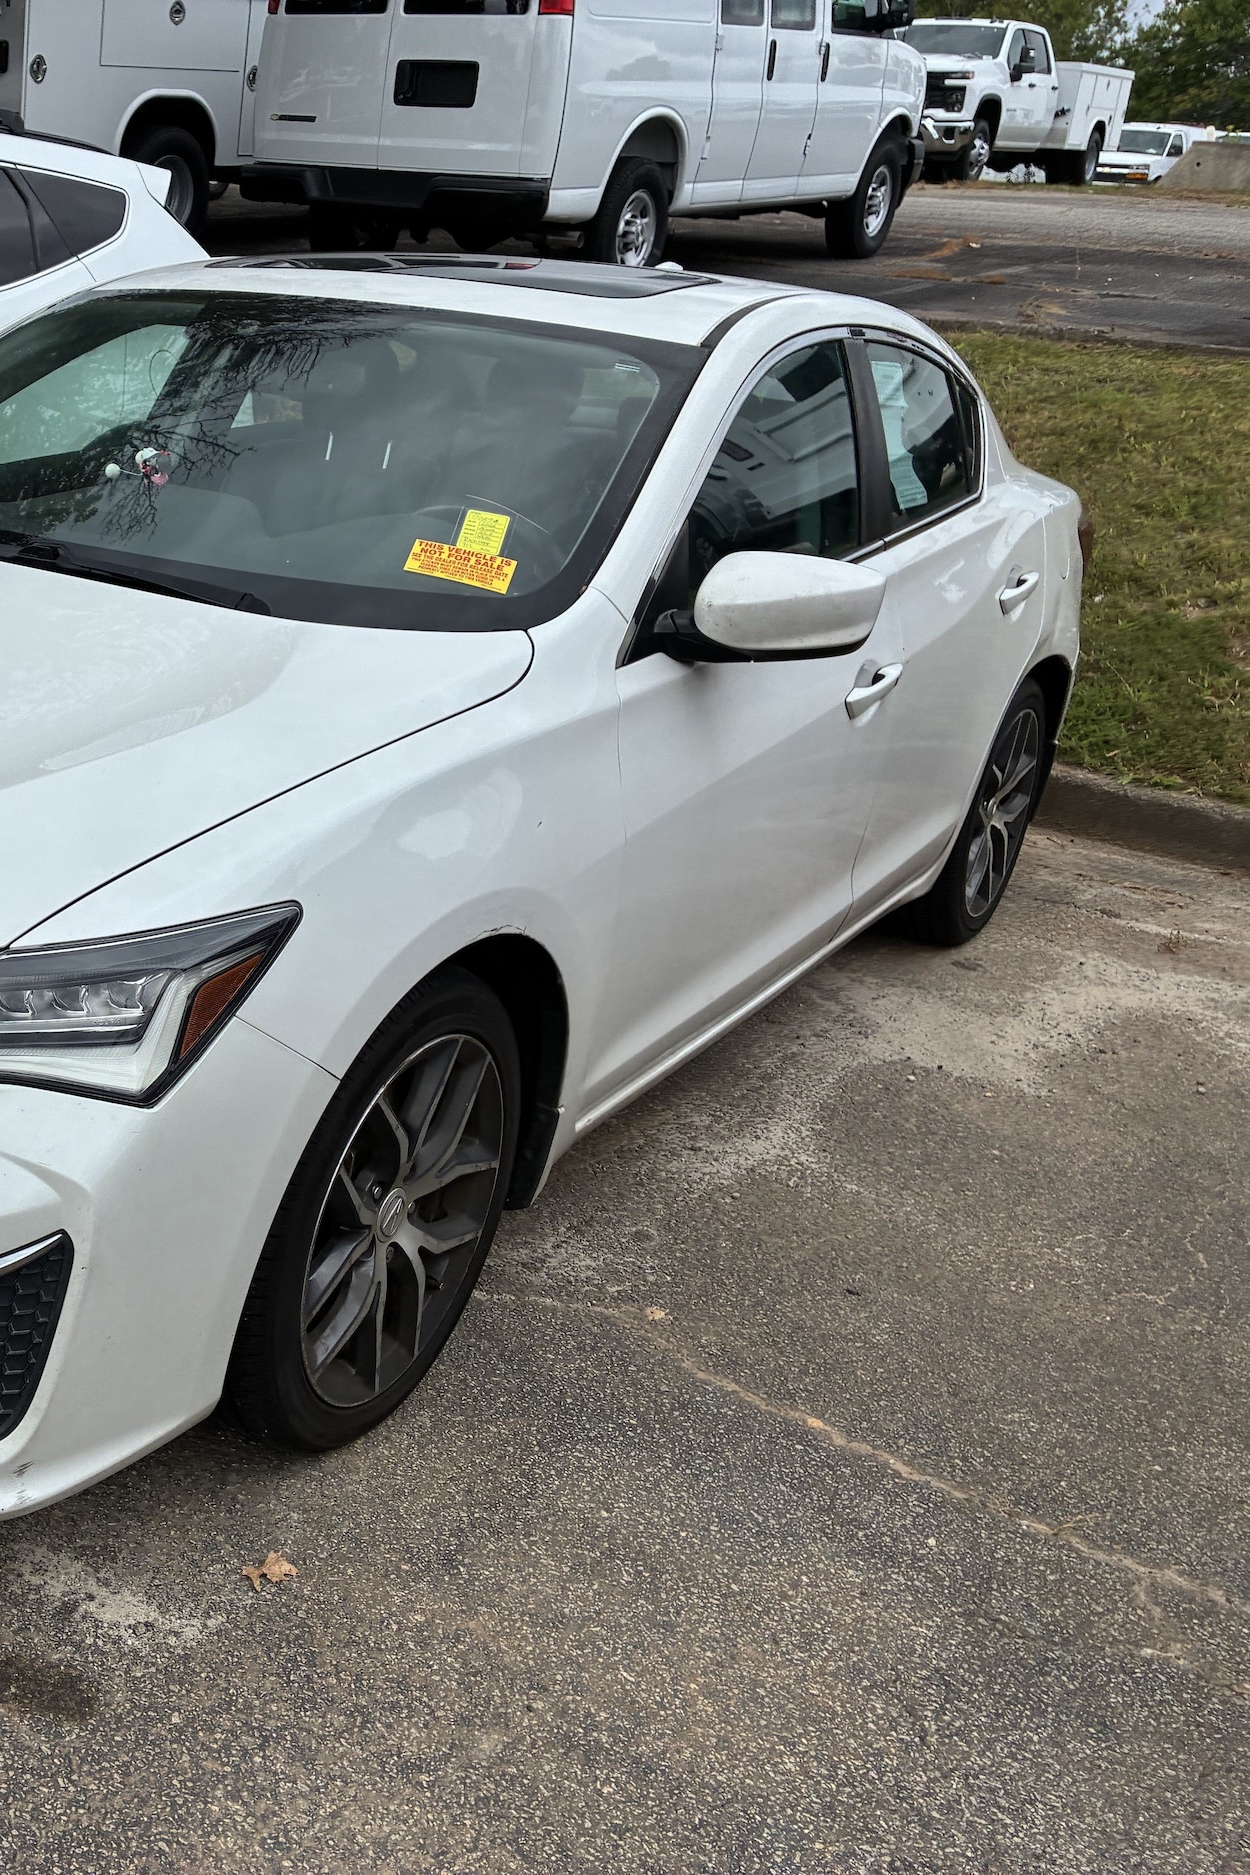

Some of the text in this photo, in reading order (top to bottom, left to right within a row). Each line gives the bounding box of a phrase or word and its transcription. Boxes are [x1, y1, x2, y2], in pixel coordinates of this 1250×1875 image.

[418, 540, 512, 566] THIS VEHICLE IS
[420, 547, 504, 571] NOT FOR SALE
[469, 564, 493, 574] RELEASE
